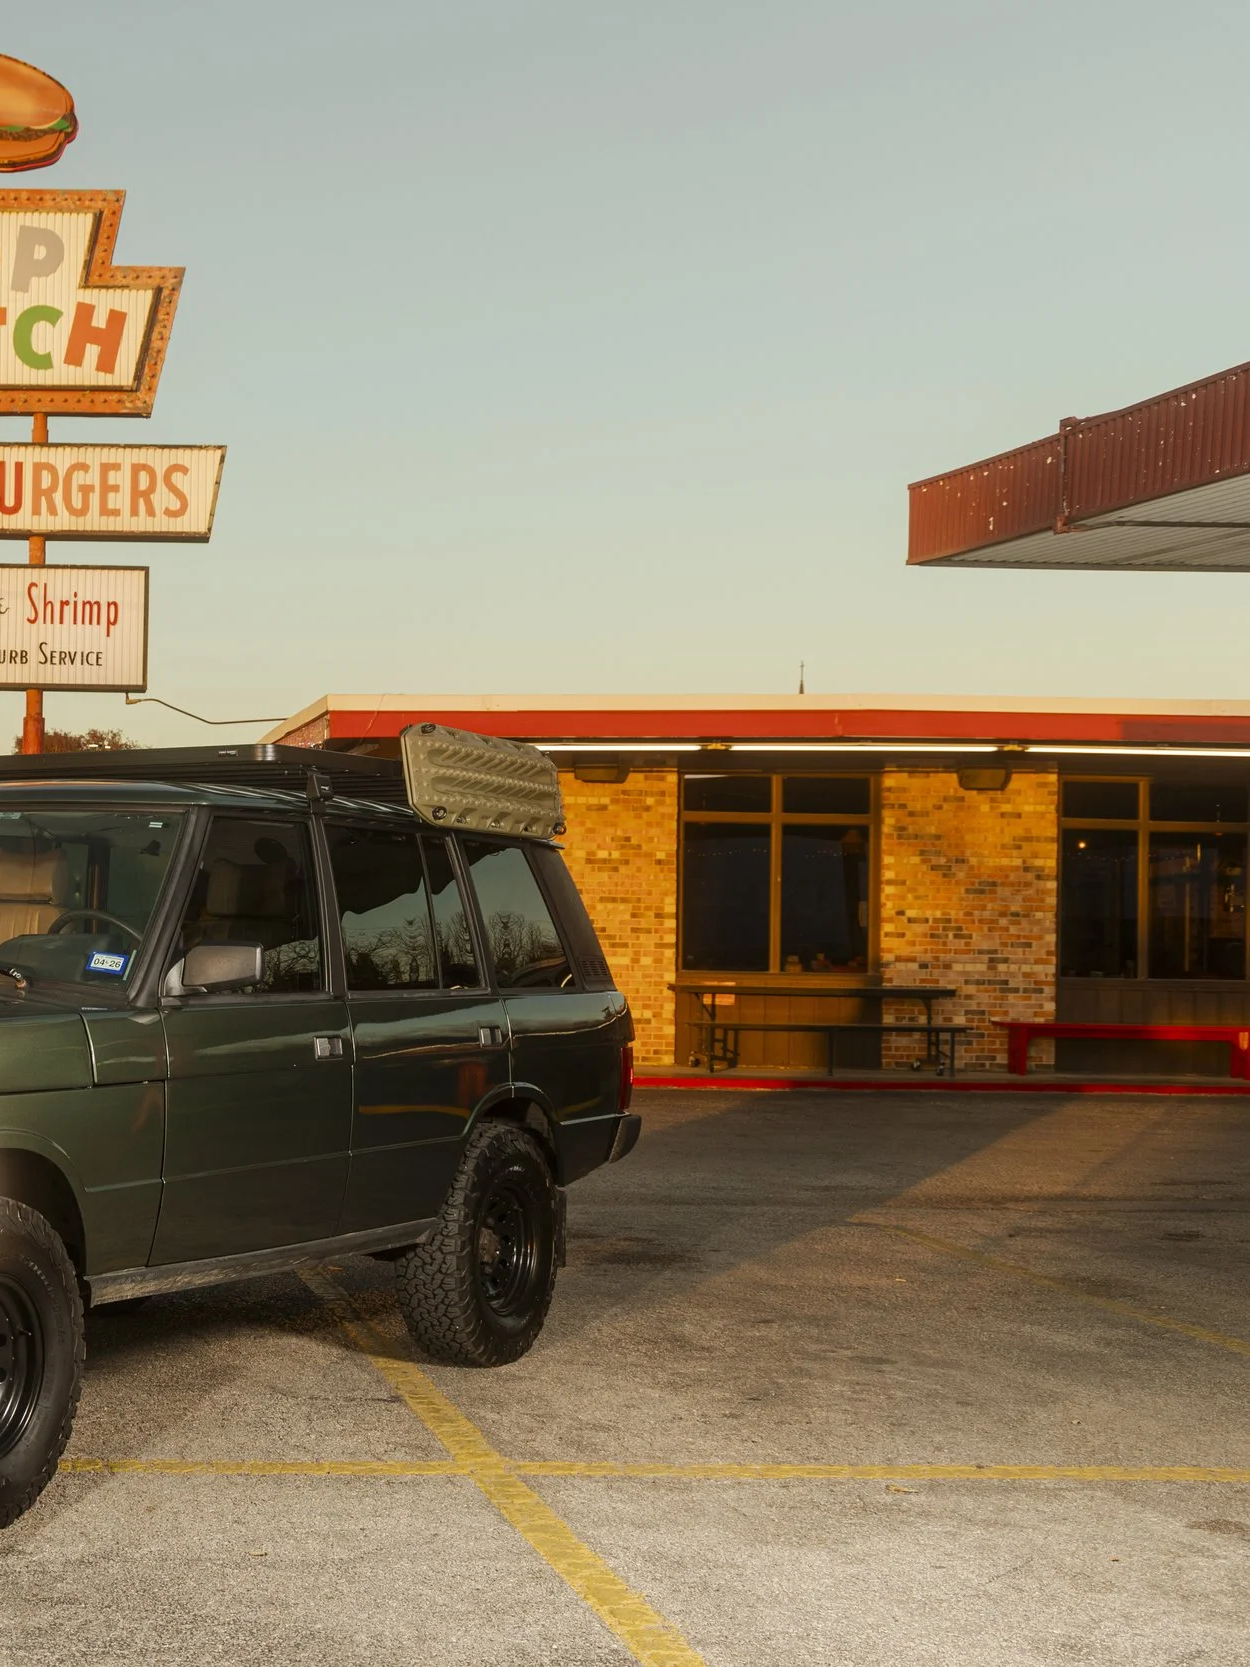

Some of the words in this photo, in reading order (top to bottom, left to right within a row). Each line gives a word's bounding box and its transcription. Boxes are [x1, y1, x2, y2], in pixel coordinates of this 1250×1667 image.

[26, 582, 120, 637] Shrimp
[39, 641, 103, 666] SERVICE
[93, 958, 105, 966] 04
[109, 960, 121, 968] 26
